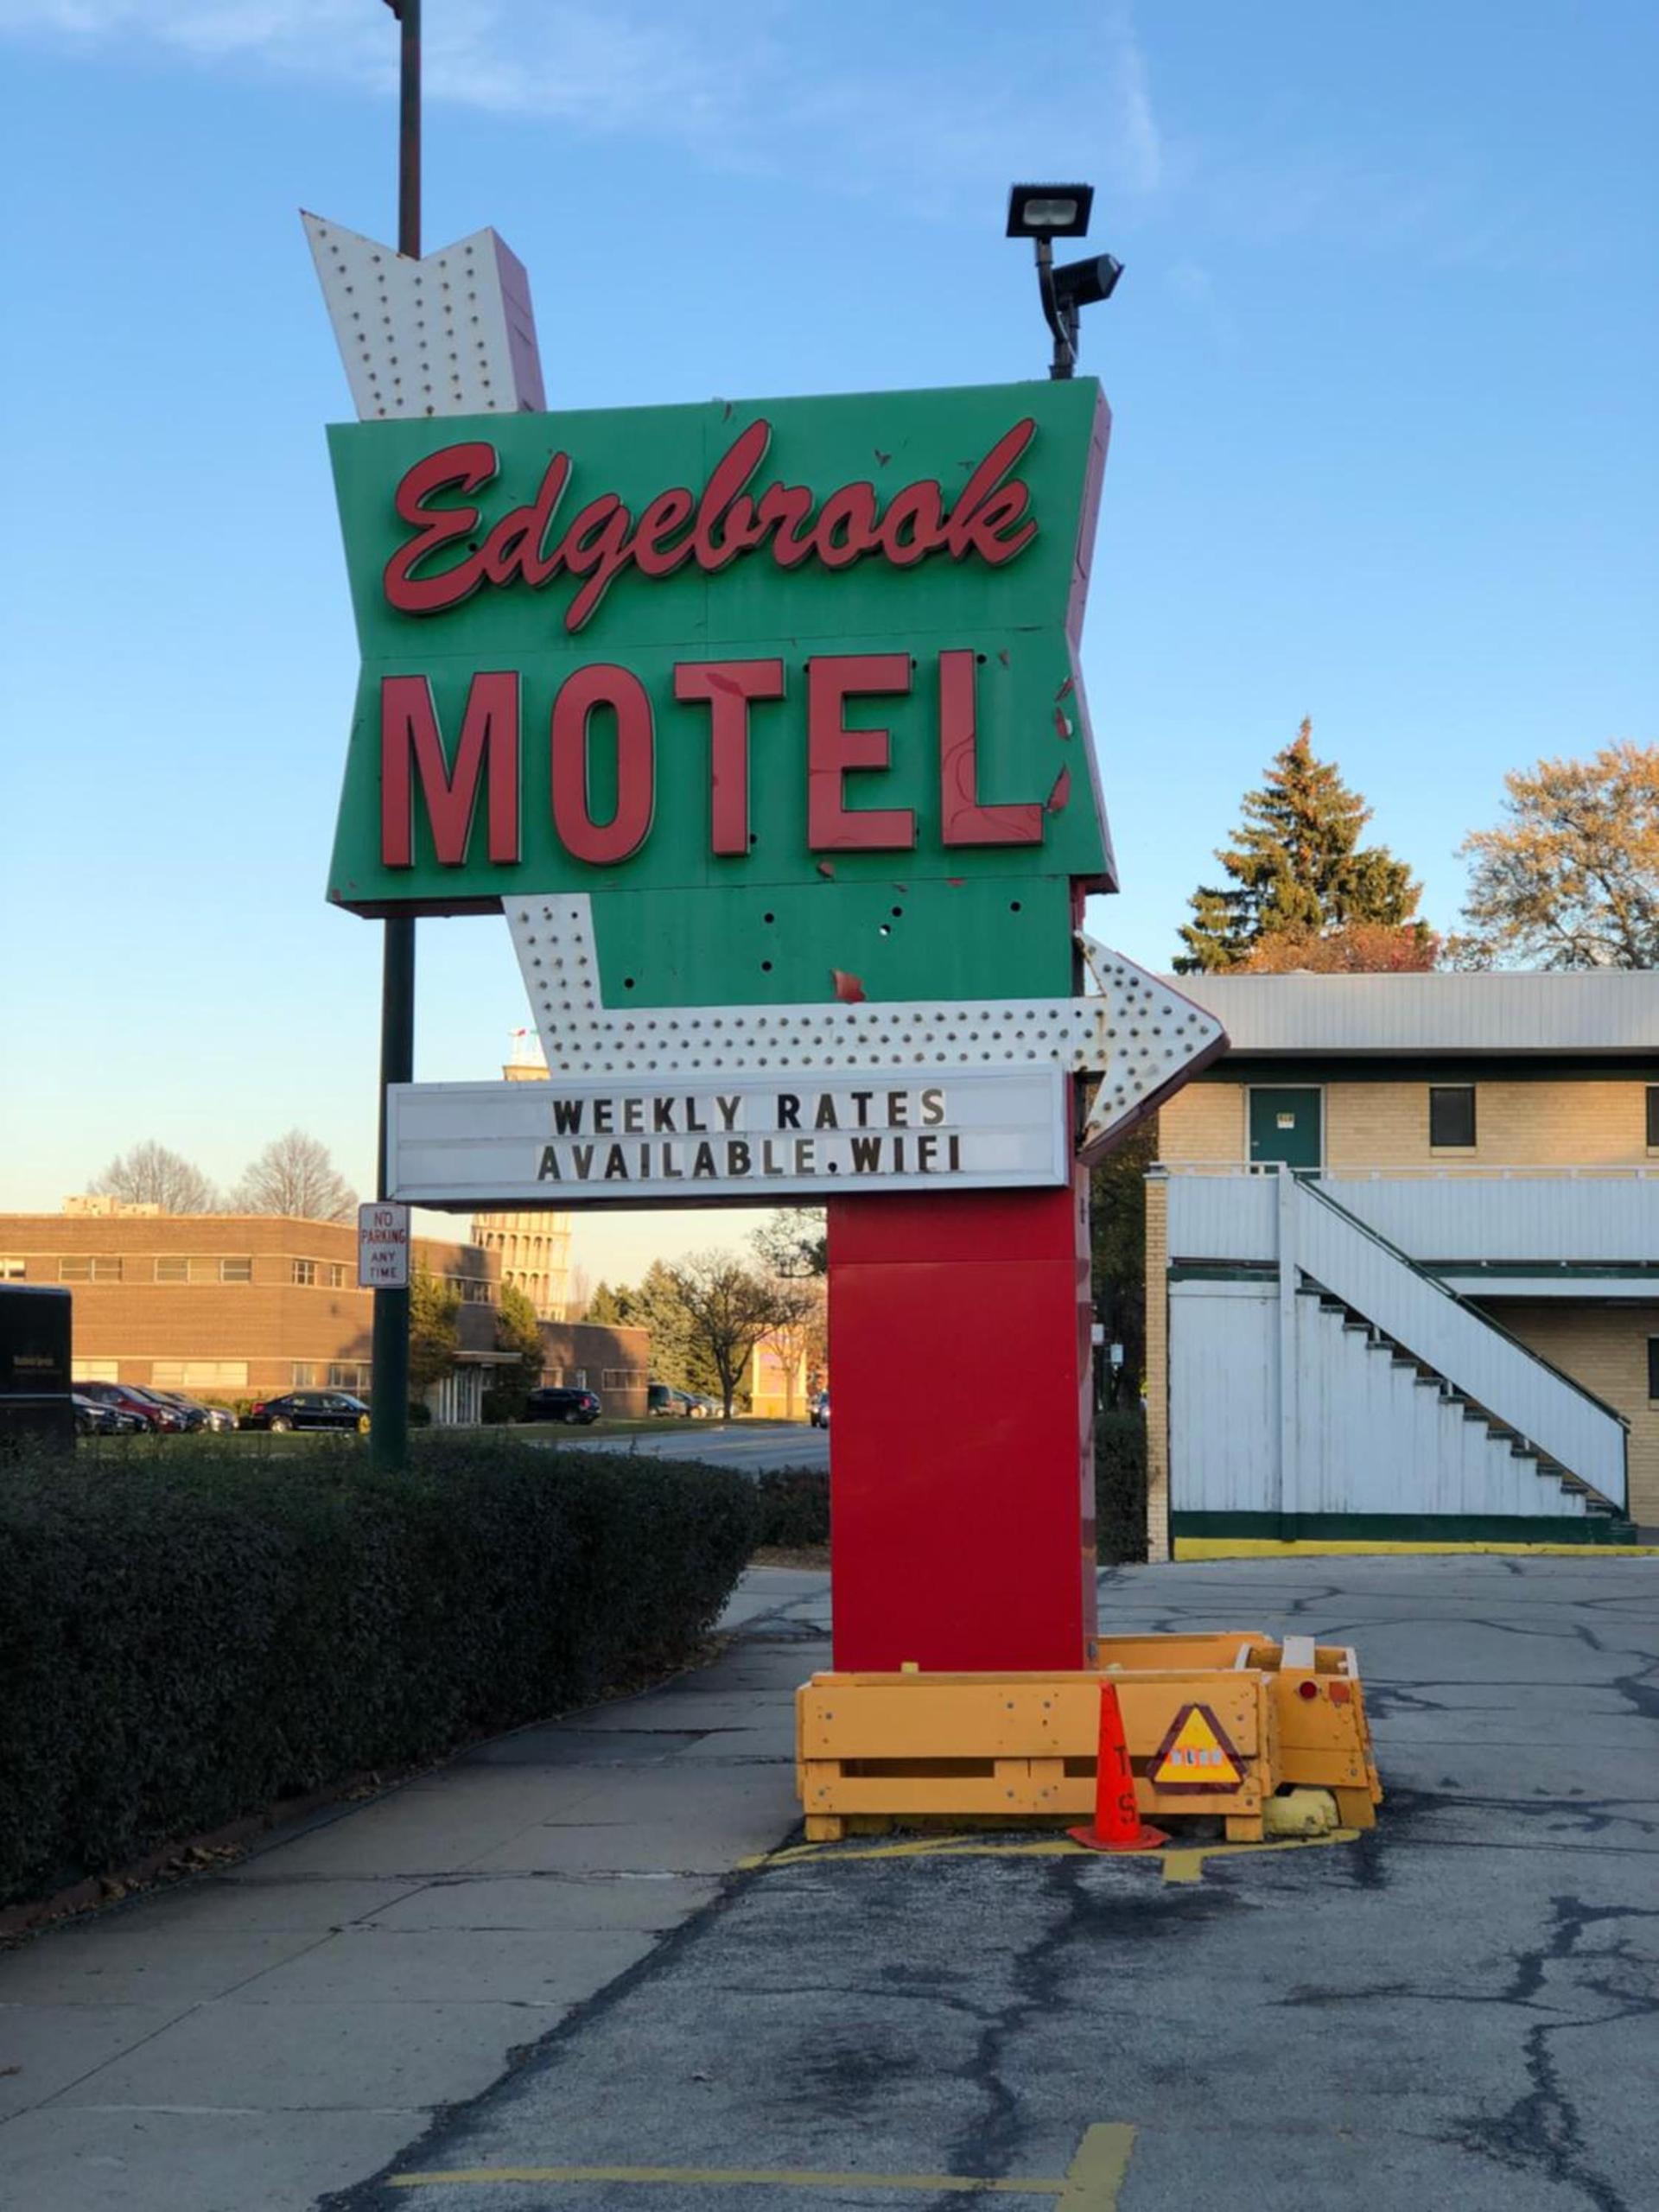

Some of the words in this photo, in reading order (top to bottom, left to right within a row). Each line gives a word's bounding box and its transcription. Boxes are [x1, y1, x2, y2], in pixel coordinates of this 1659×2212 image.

[384, 417, 1039, 633] Edgebrook
[380, 648, 1044, 868] MOTEL
[553, 1096, 741, 1135] WEEKLY
[778, 1088, 944, 1129] RATES
[374, 1211, 393, 1227] NO
[361, 1229, 405, 1244] PARKING
[372, 1251, 395, 1262] ANY
[371, 1267, 397, 1278] TIME
